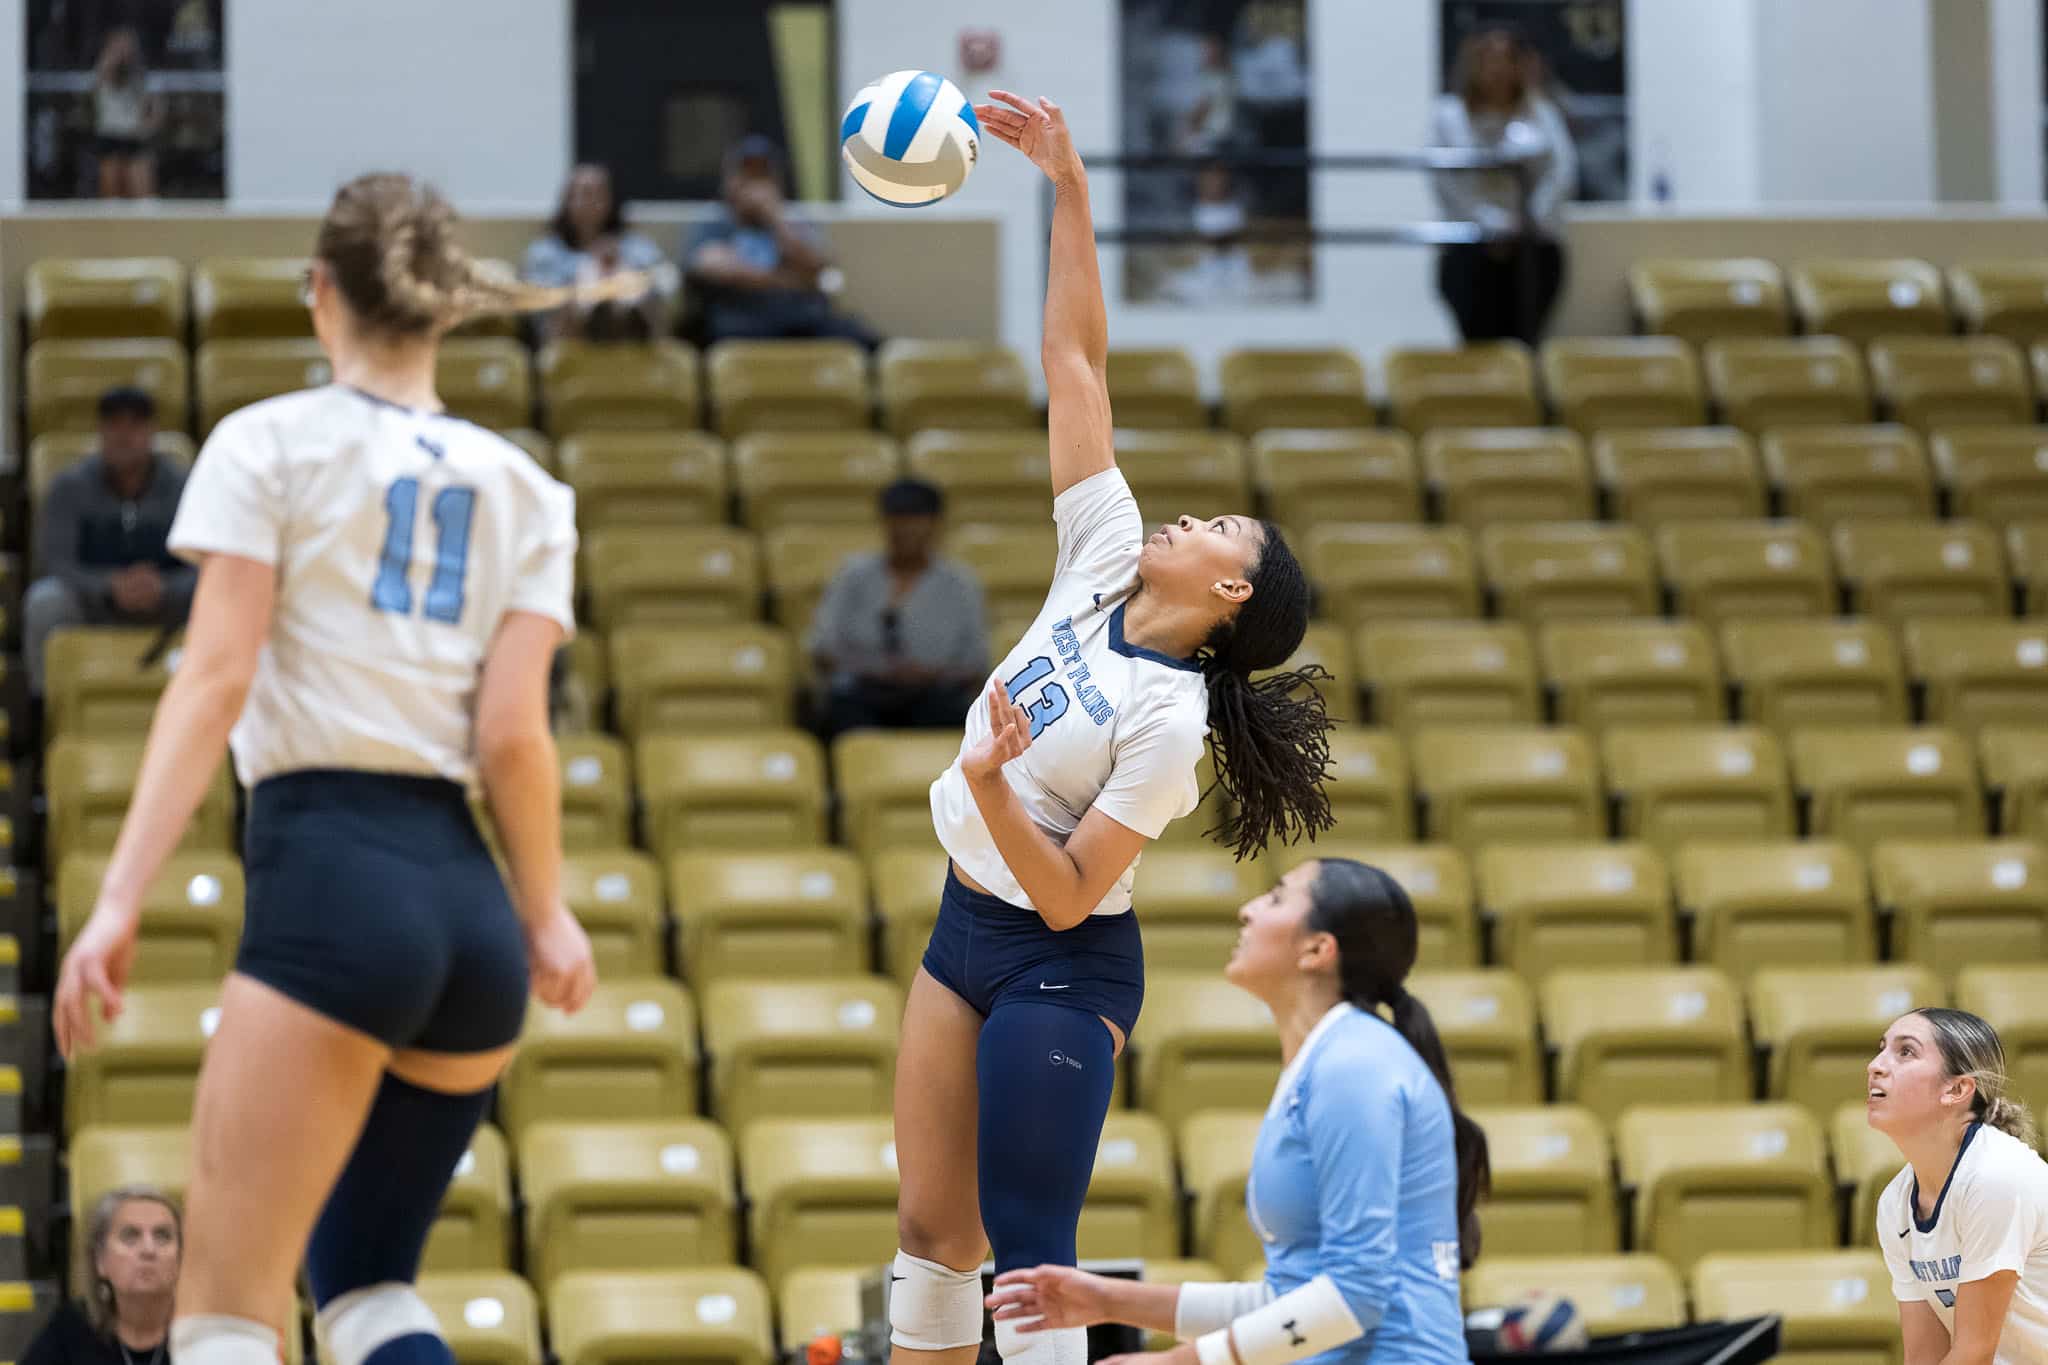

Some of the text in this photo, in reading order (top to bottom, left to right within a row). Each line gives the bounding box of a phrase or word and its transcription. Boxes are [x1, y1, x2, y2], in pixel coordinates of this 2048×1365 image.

[369, 475, 477, 625] 11
[1004, 656, 1070, 741] 13
[1066, 661, 1115, 726] PLAINS
